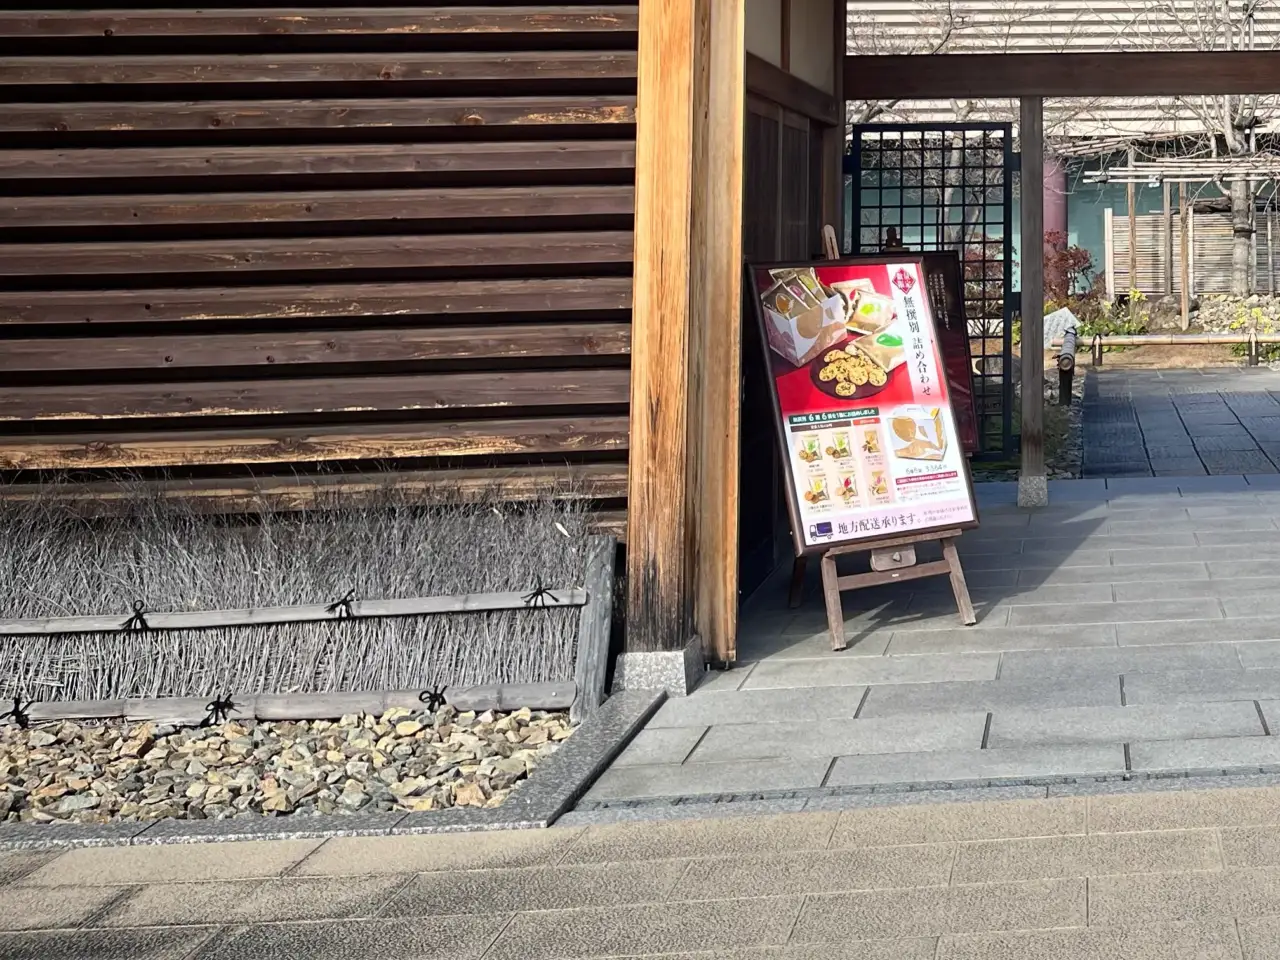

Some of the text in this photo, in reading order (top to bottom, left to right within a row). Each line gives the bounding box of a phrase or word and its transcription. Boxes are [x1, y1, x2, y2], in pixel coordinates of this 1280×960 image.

[912, 337, 931, 396] 詰め合わせ
[838, 512, 921, 535] 地方配送承ります。
